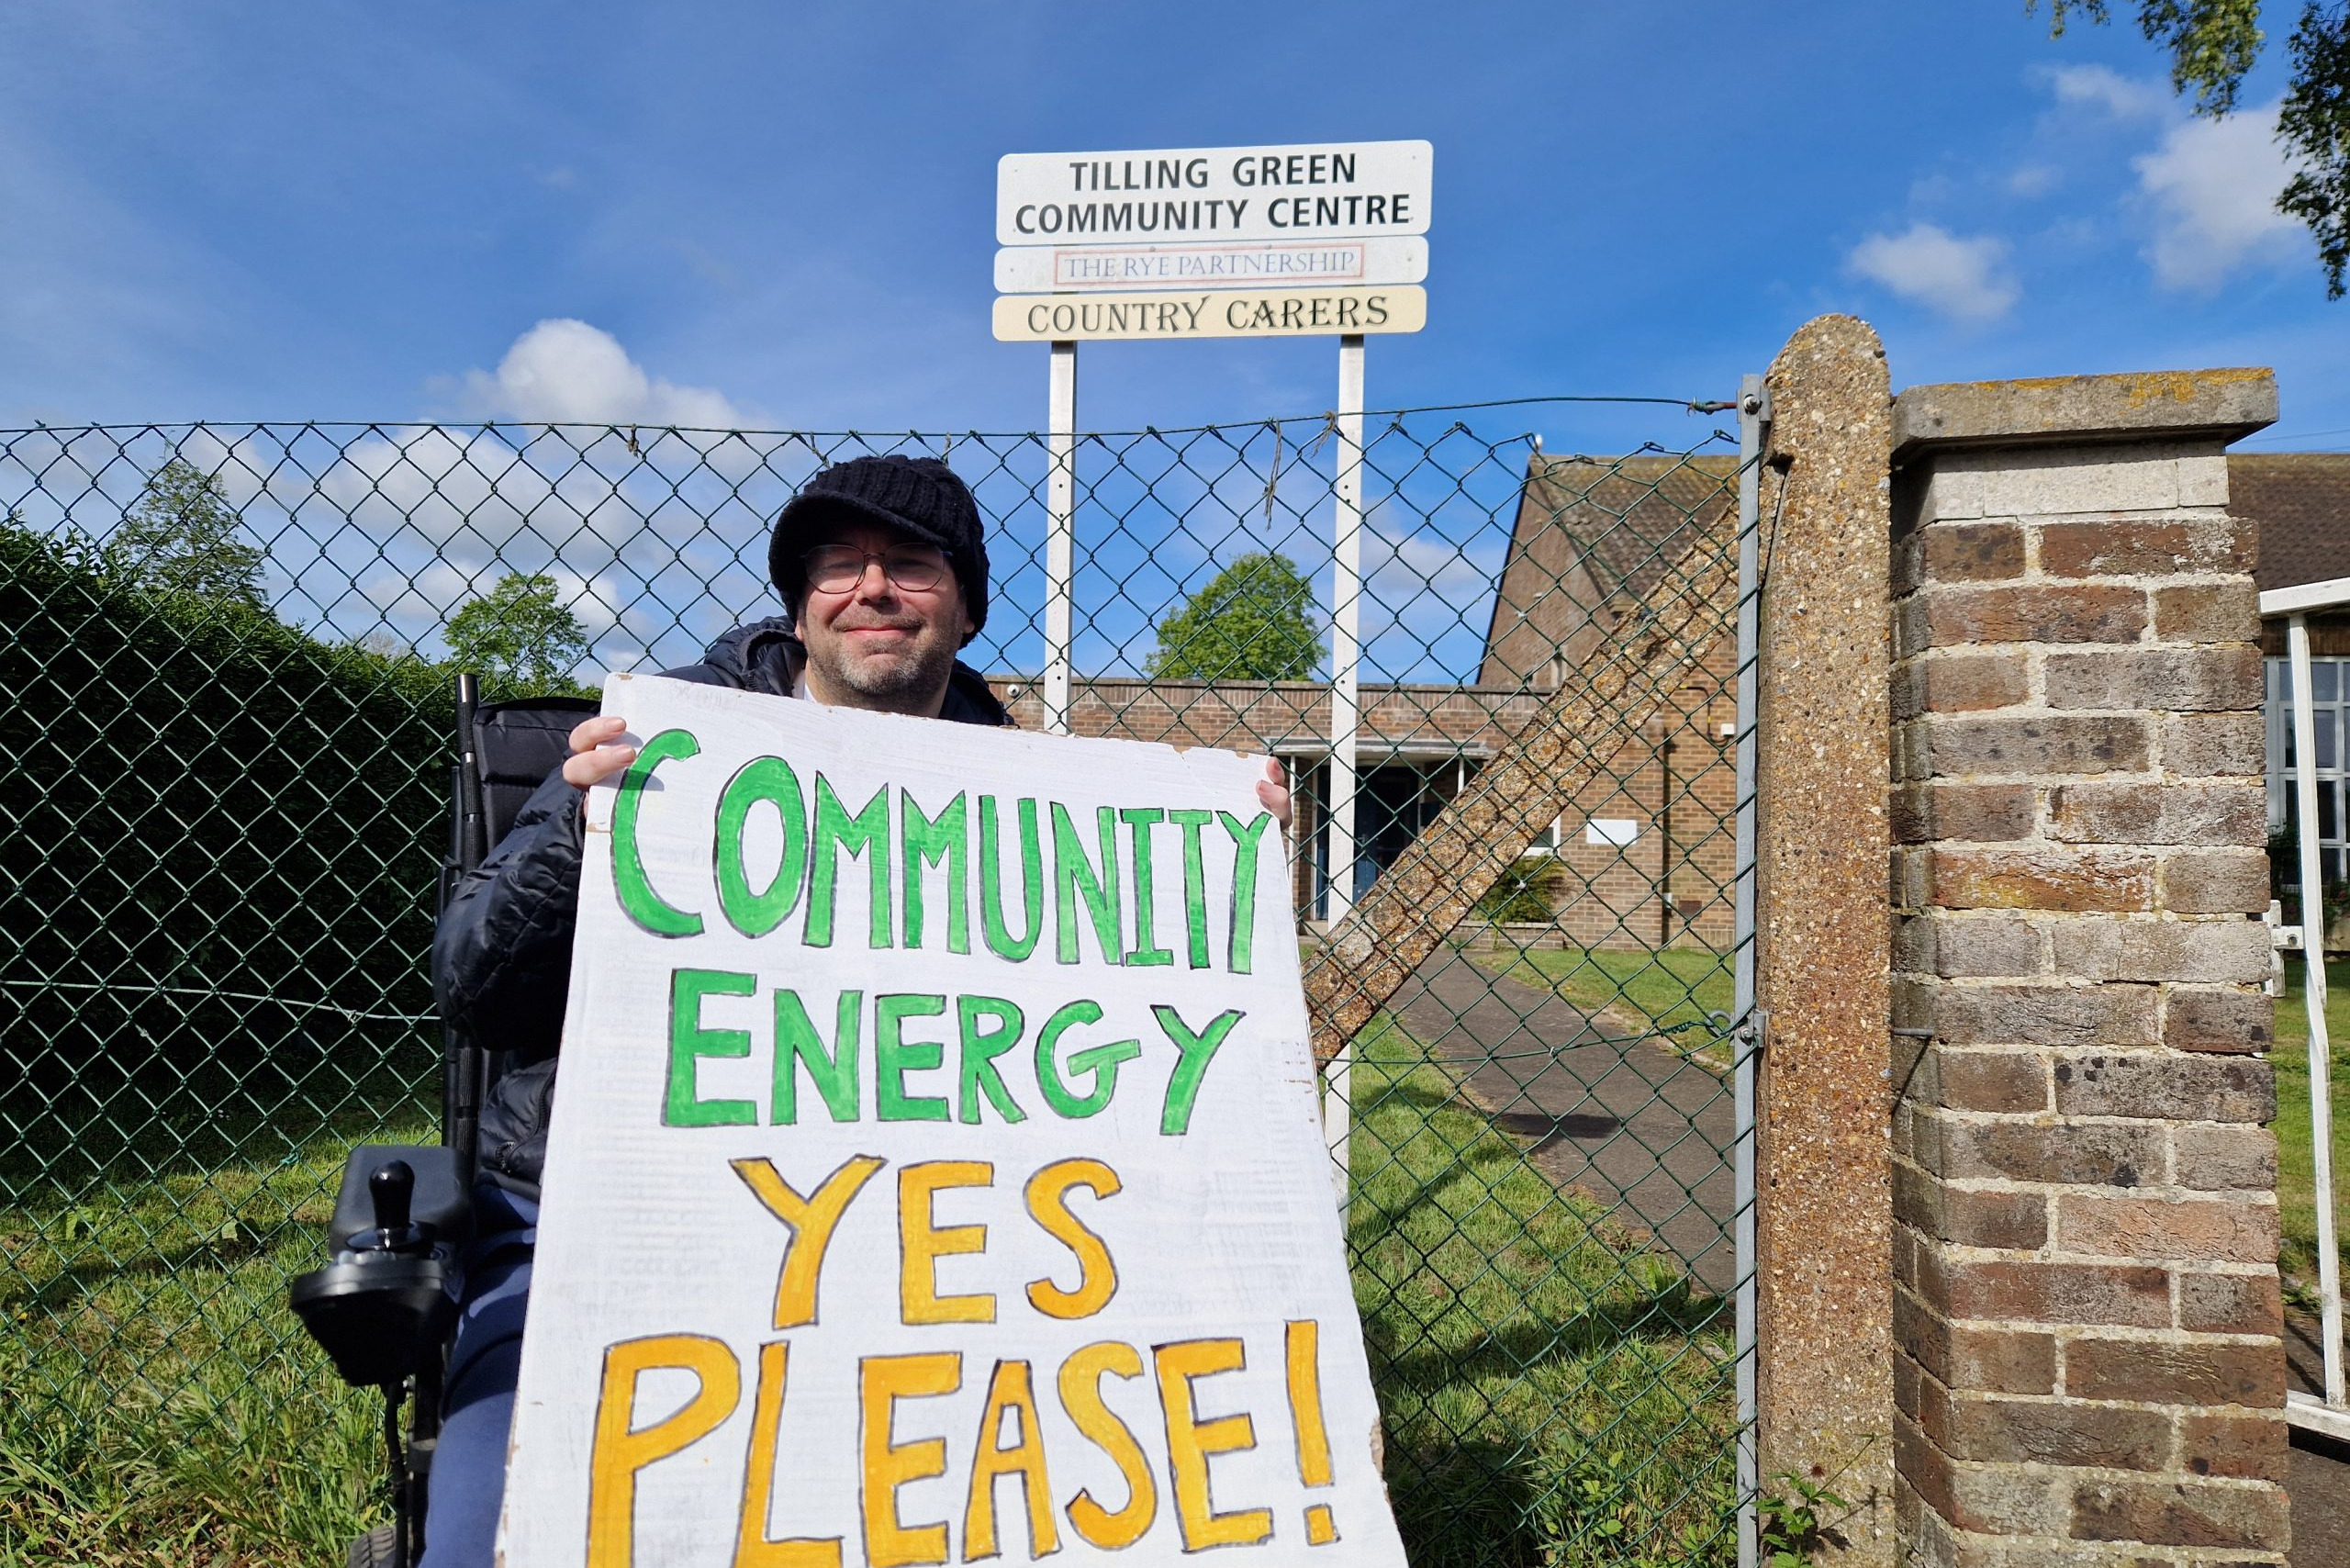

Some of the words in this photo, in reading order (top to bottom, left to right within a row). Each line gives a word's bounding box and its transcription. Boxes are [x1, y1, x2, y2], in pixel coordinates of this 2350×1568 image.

[1014, 199, 1249, 234] COMMUNITY
[1268, 194, 1411, 229] CENTRE
[1069, 158, 1209, 191] TILLING
[1232, 153, 1357, 188] GREEN
[1027, 295, 1211, 334] COUNTRY
[1225, 296, 1389, 330] CARERS
[1065, 258, 1116, 277] THE
[1124, 256, 1170, 276] RYE
[1179, 252, 1355, 274] PARTNERSHIP
[610, 728, 1272, 975] COMMUNITY
[660, 967, 1246, 1137] ENERGY
[729, 1153, 1123, 1329] YES
[585, 1319, 1342, 1568] PLEASE!
